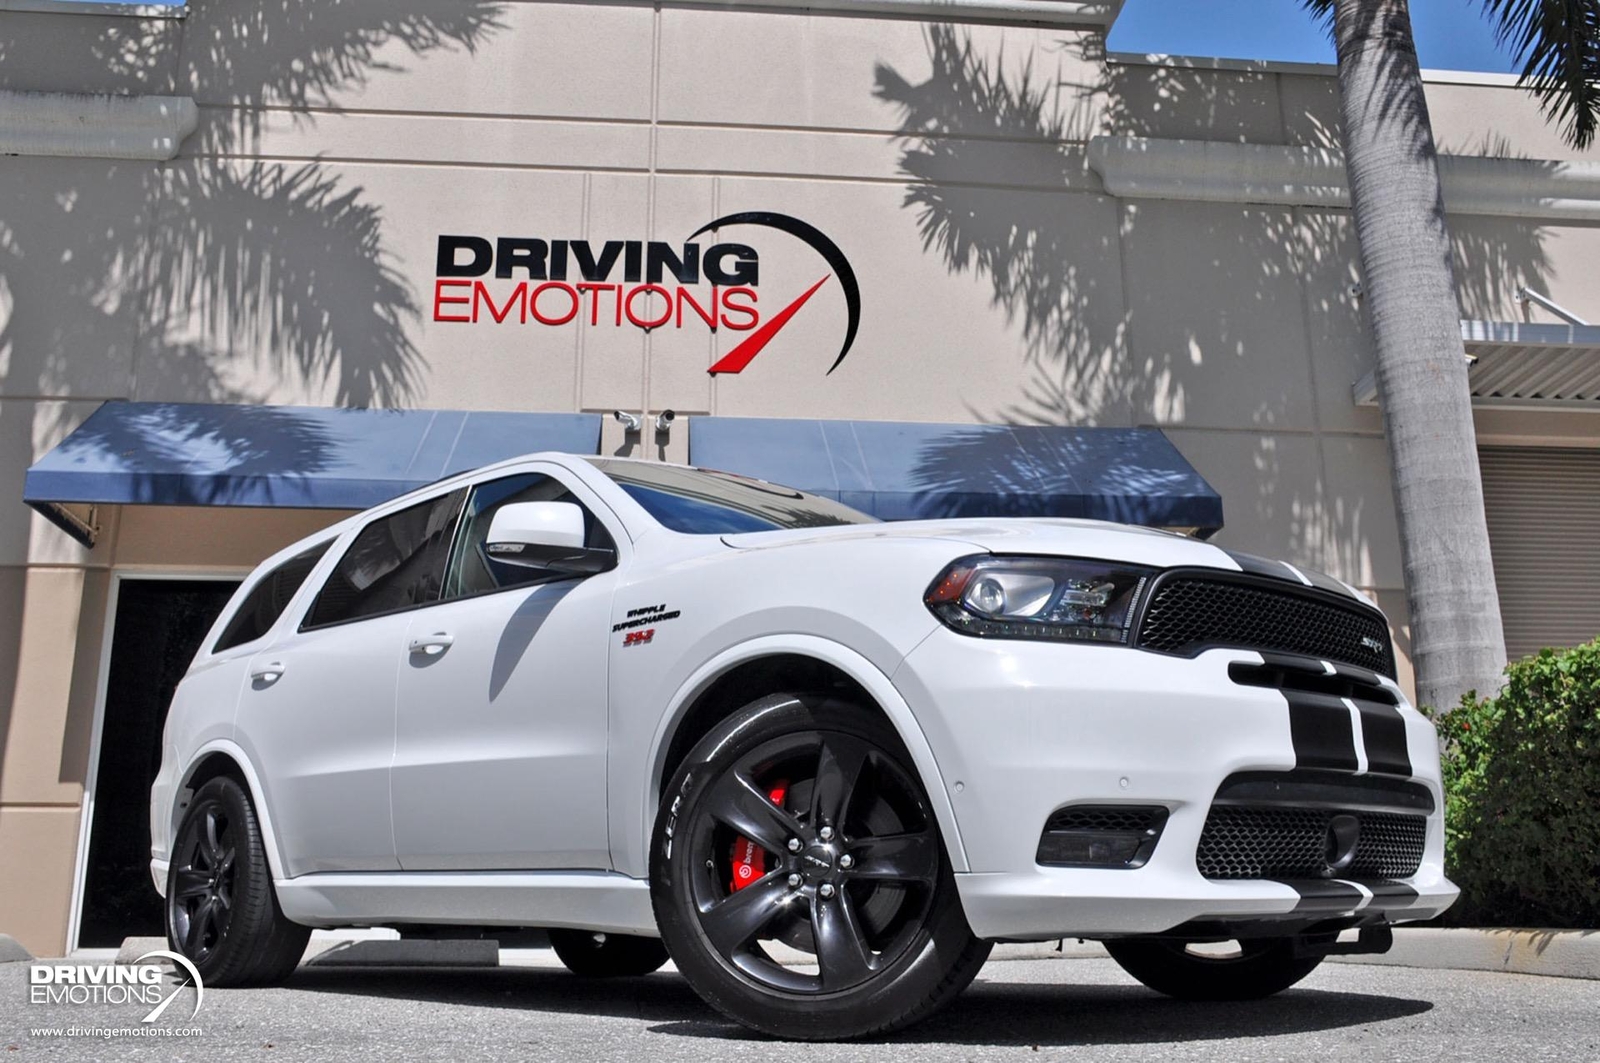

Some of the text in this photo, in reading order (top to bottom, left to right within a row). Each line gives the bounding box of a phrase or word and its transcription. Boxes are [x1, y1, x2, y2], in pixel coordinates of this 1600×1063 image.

[436, 235, 759, 286] DRIVING
[434, 280, 759, 331] EMOTIONS
[612, 610, 681, 632] SUPERCHARGED
